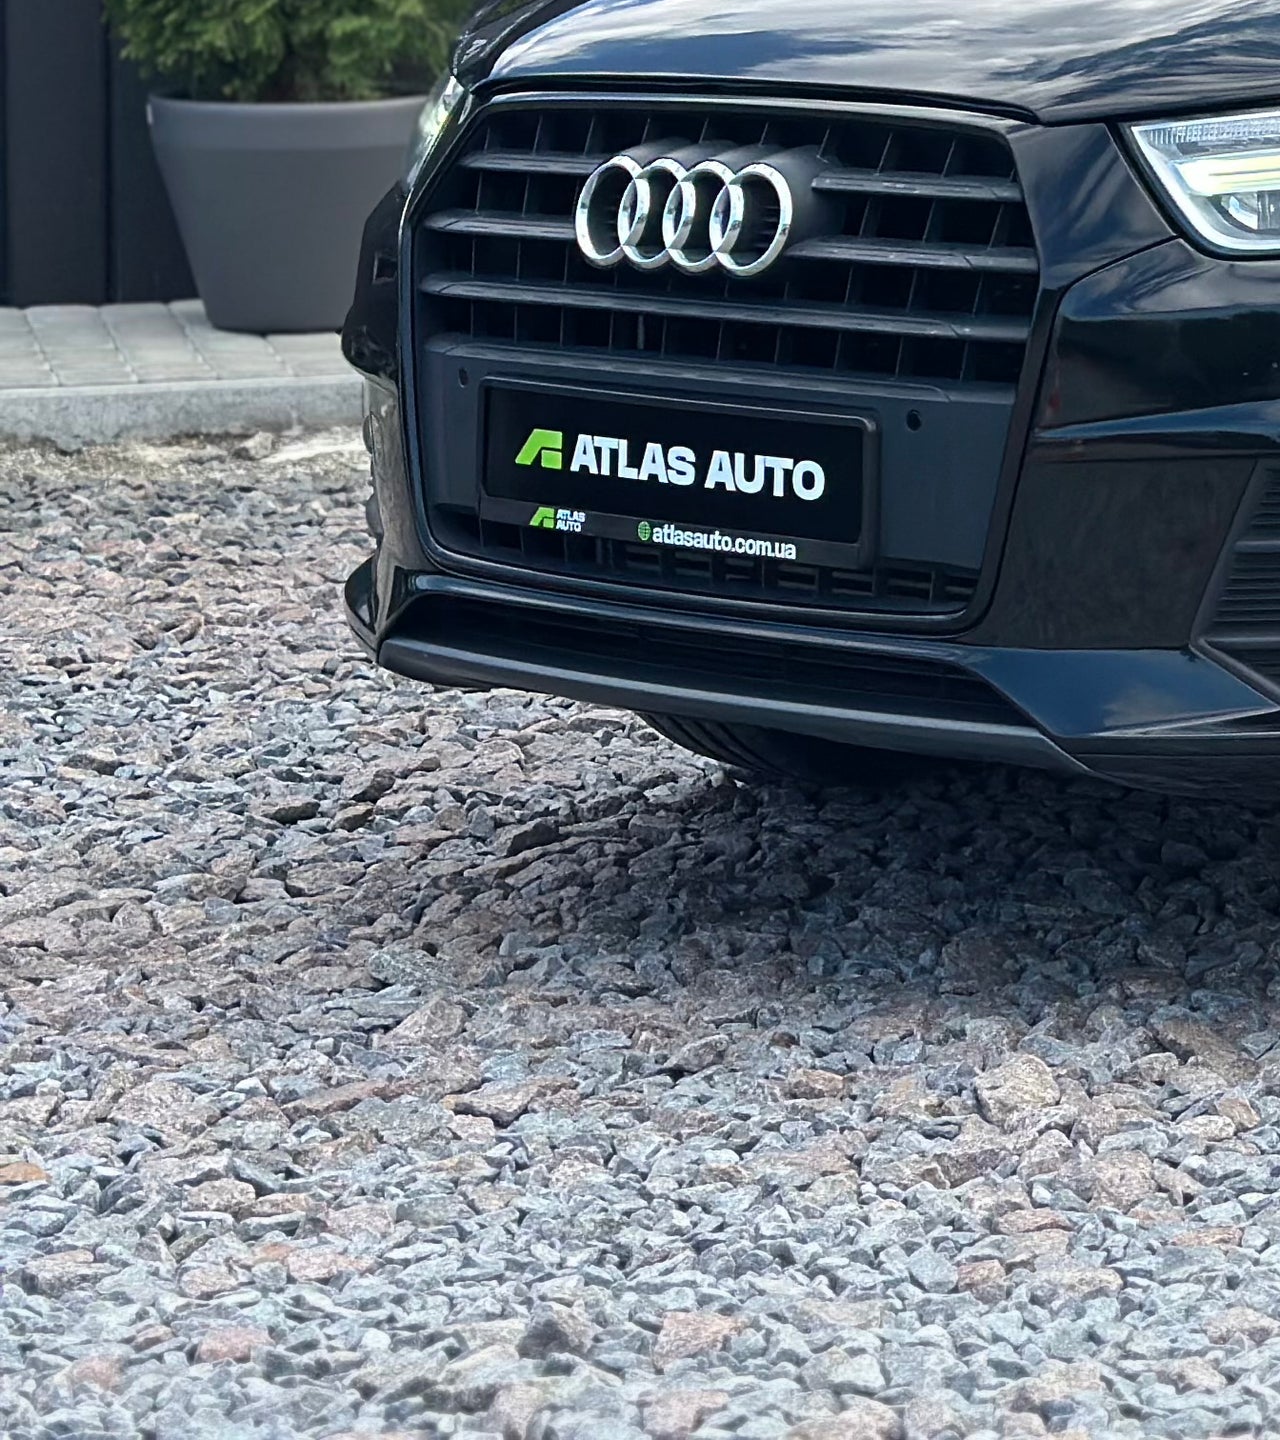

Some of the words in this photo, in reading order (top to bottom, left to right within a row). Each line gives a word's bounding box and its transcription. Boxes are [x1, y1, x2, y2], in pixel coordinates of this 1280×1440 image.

[569, 434, 696, 486] ATLAS
[704, 450, 826, 501] AUTO
[556, 509, 586, 522] ATLAS
[556, 520, 582, 532] AUTO
[652, 523, 797, 560] atlasauto.com.ua
